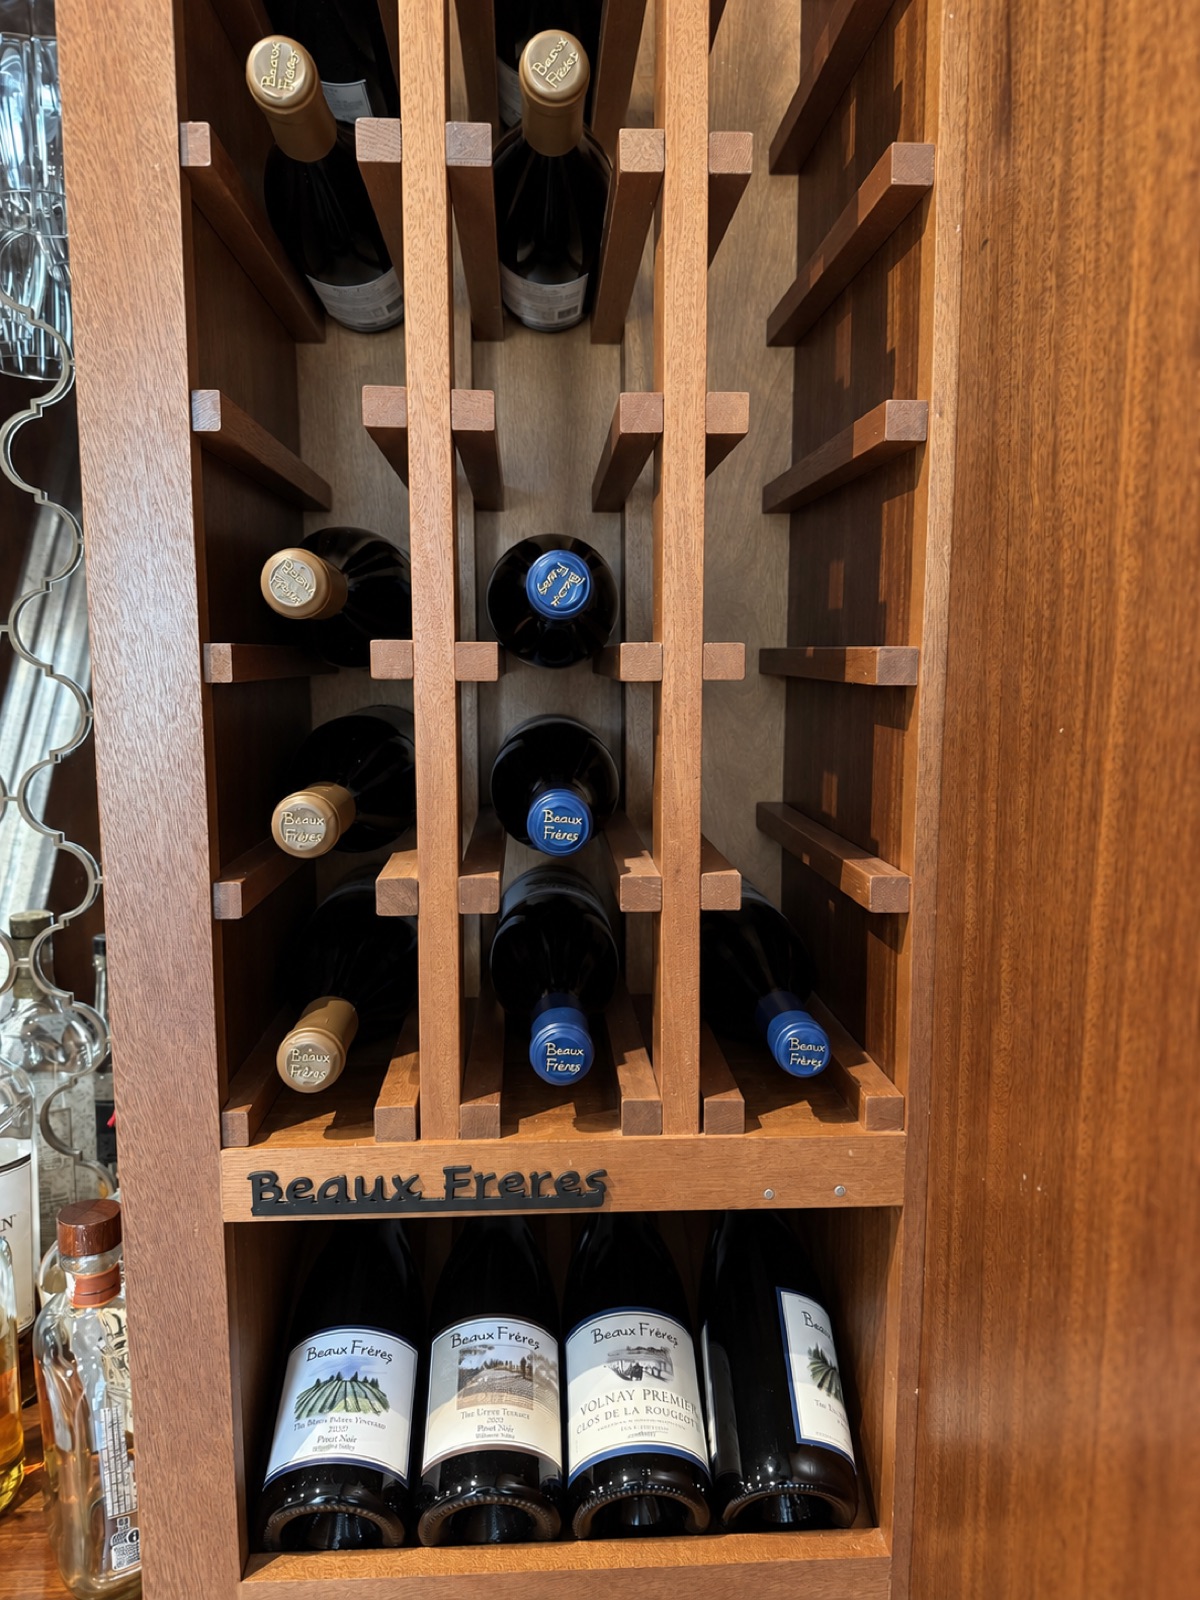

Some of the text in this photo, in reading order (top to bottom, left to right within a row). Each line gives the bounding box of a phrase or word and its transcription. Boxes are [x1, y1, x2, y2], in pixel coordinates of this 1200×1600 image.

[281, 811, 325, 826] Beaux
[542, 808, 583, 825] Beaux
[544, 1042, 585, 1056] Beaux
[788, 1037, 826, 1052] Beaux
[290, 1048, 331, 1063] Beaux
[247, 1164, 608, 1203] Beaux Freres
[450, 1331, 496, 1350] Beaux
[590, 1326, 637, 1345] Beaux
[305, 1345, 349, 1363] Beaux
[579, 1388, 699, 1420] VOLNAY PREMIER
[576, 1413, 600, 1435] CLOS
[604, 1408, 620, 1421] DE
[624, 1406, 640, 1416] LA
